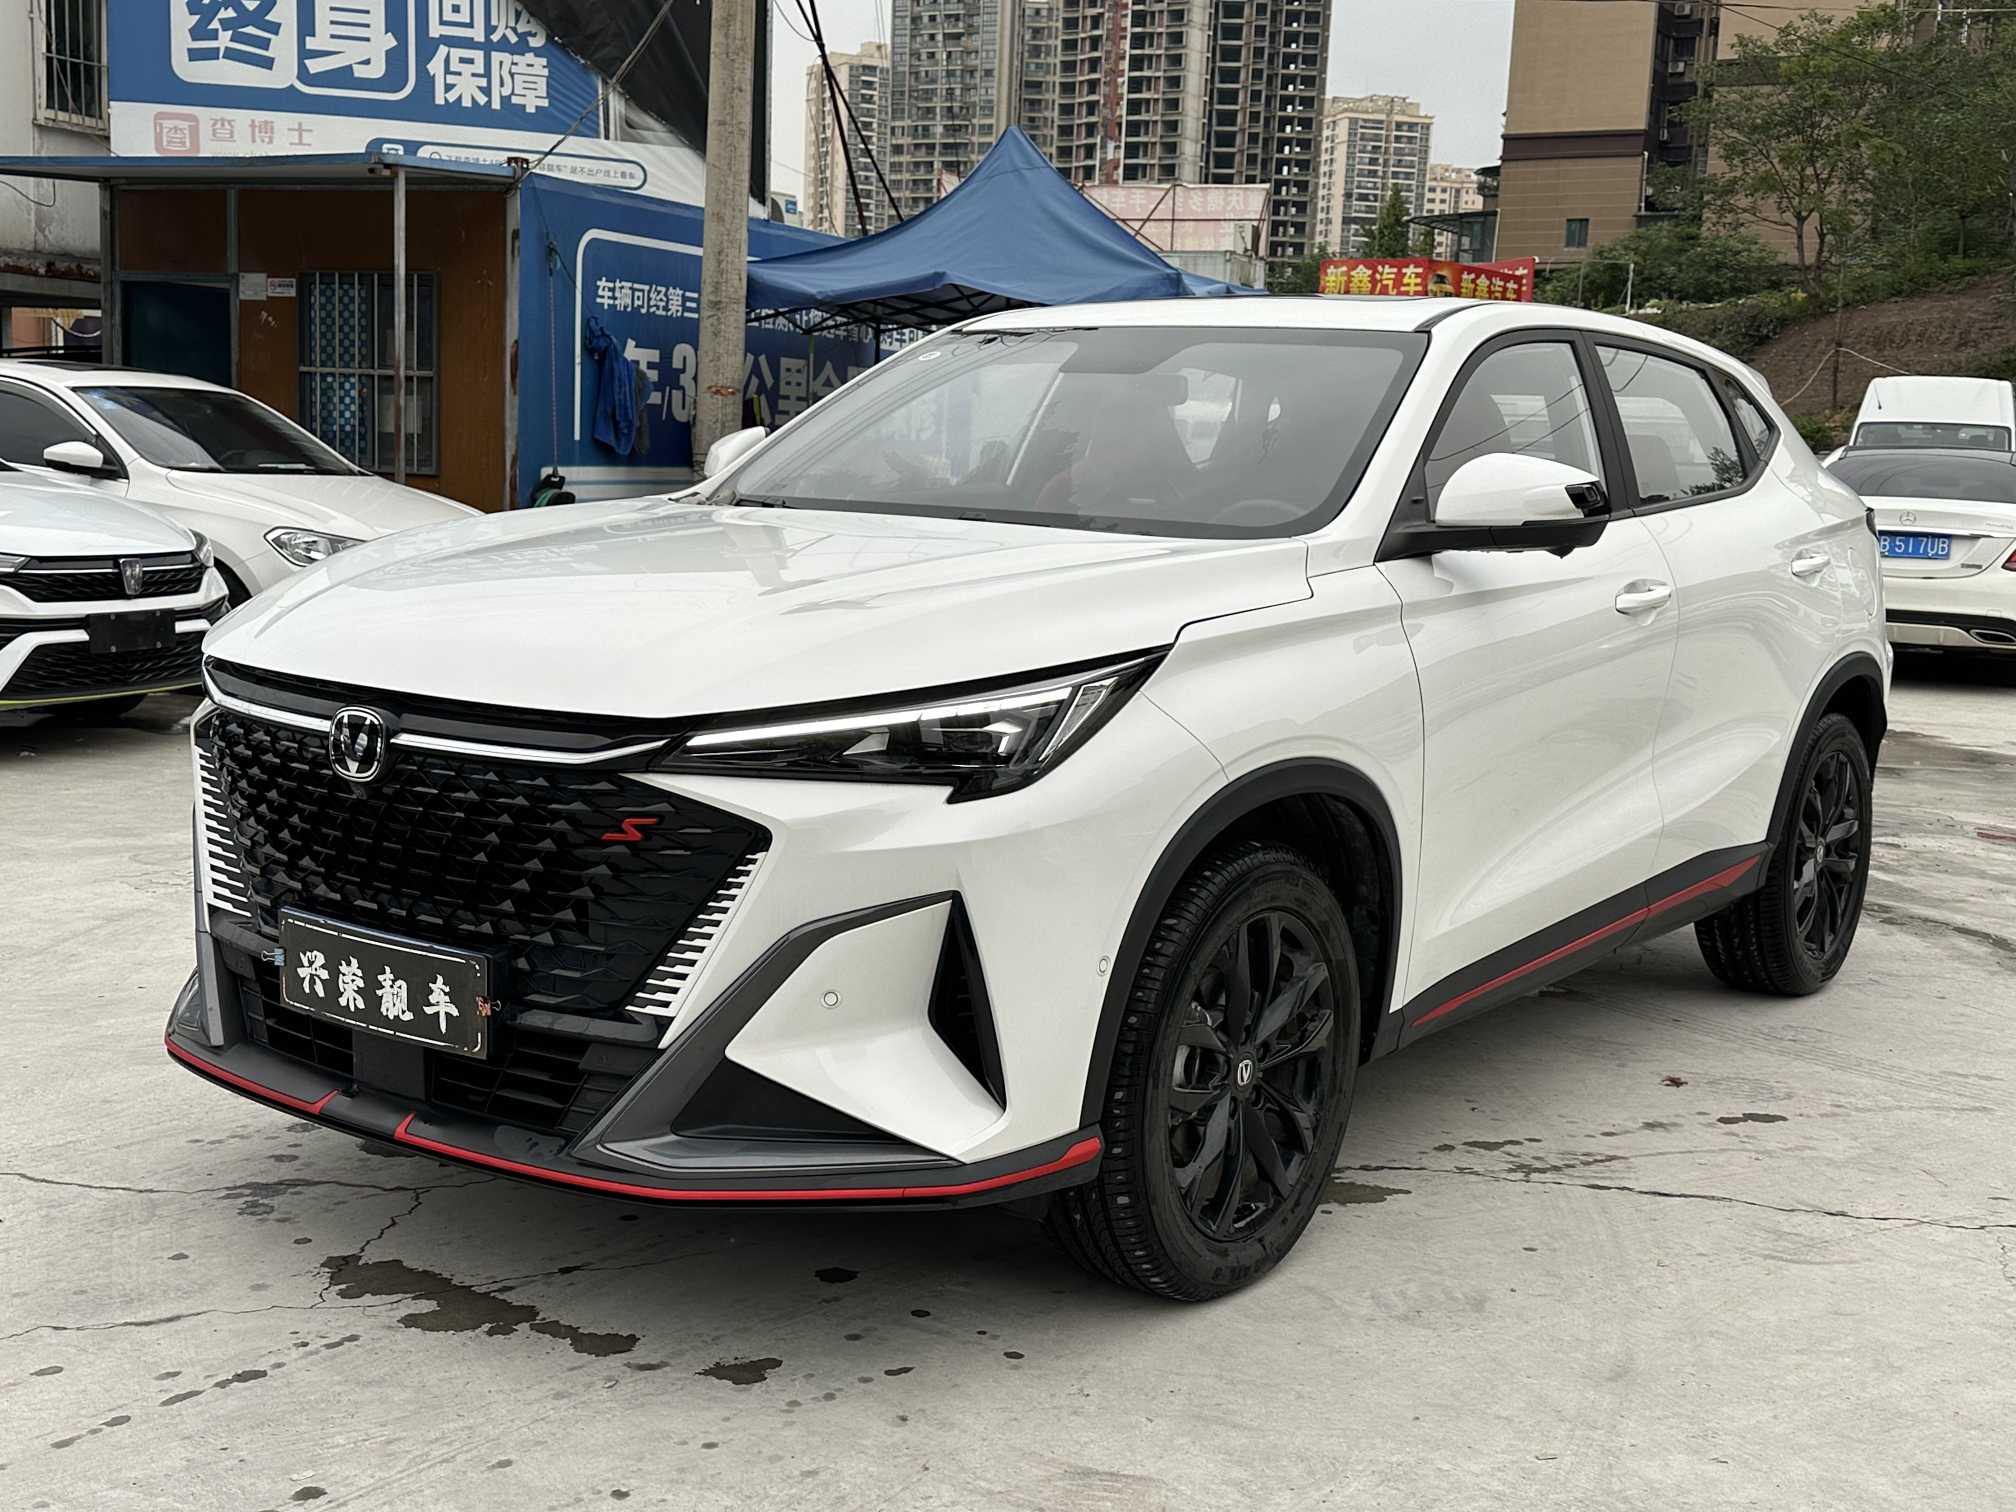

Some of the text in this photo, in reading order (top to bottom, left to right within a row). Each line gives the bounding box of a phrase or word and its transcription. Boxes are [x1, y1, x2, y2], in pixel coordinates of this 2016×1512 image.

[426, 45, 550, 113] 保障
[209, 116, 313, 148] 查博士
[596, 276, 699, 319] 车辆可经第三
[1323, 264, 1424, 296] 新鑫汽车
[1459, 271, 1519, 301] 新鑫汽车
[296, 950, 460, 1034] 兴荣靓车
